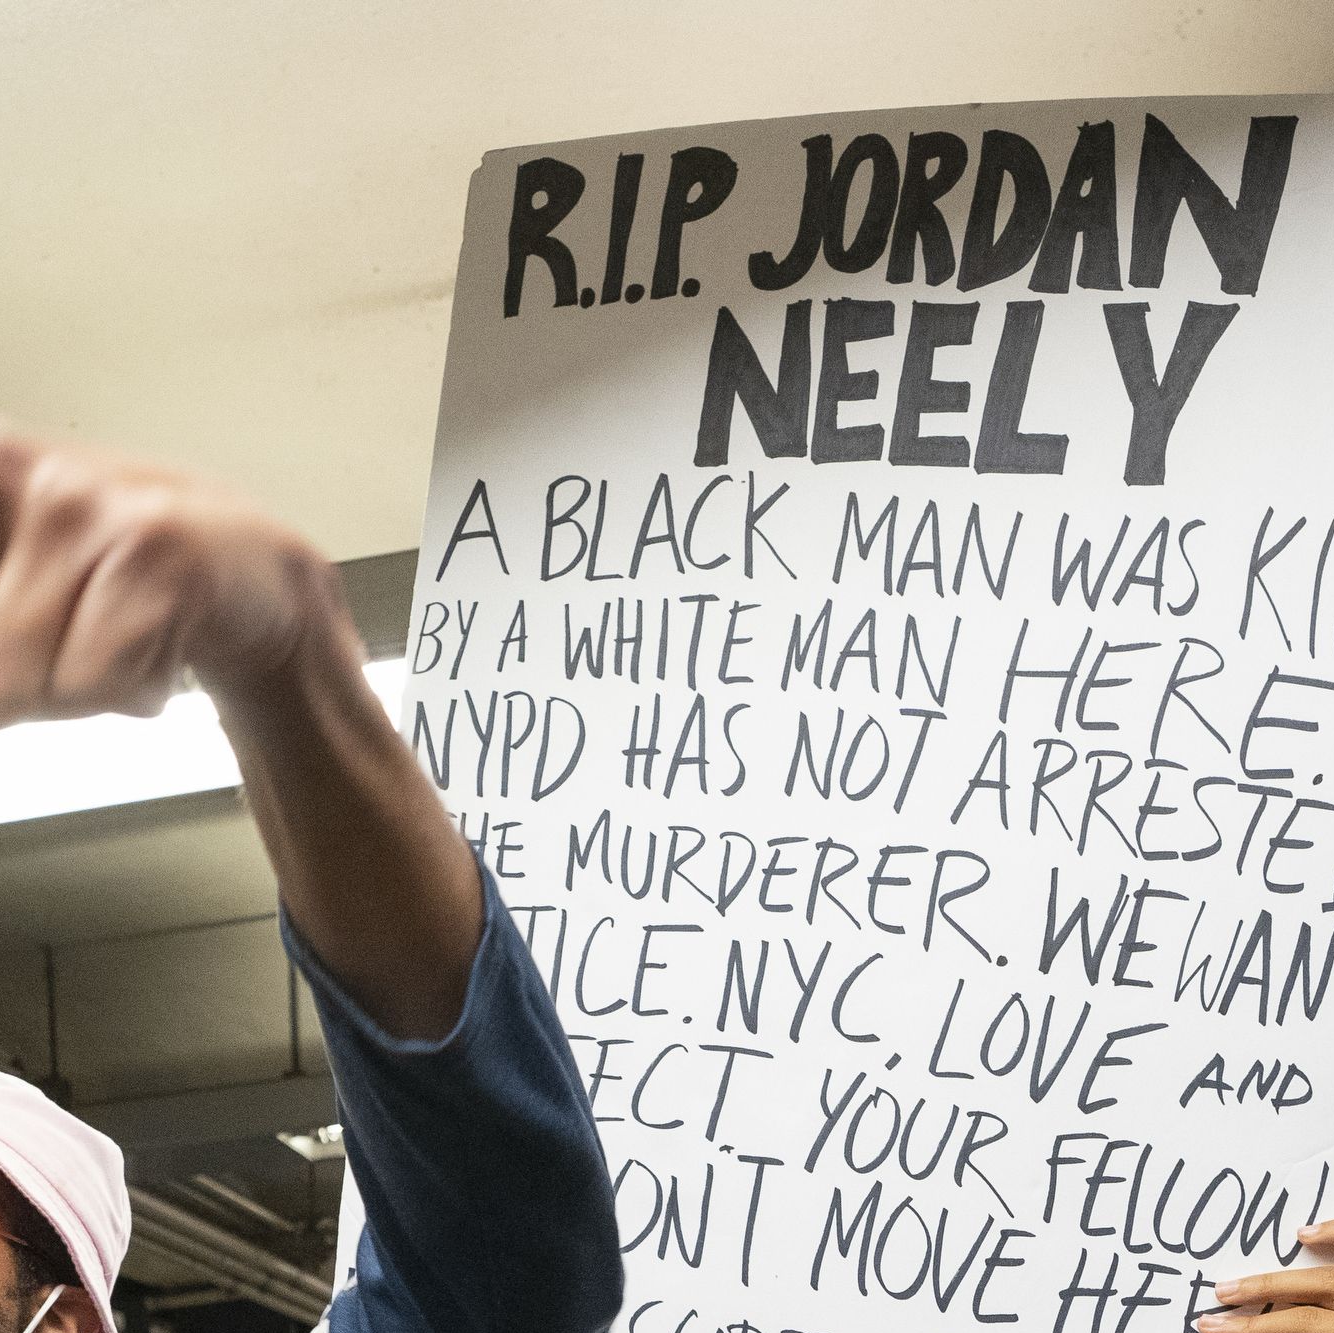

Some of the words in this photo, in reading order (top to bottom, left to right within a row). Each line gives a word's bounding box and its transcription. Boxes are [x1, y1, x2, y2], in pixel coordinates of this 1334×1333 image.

[504, 145, 739, 318] R.I.P.
[748, 113, 1299, 298] JORDAN
[693, 298, 1240, 487] NEELY
[436, 479, 509, 582] A
[540, 470, 797, 582] BLACK
[833, 492, 1022, 600] MAN
[1052, 513, 1207, 617] WAS
[413, 601, 479, 681] BY
[497, 599, 528, 673] A
[564, 594, 762, 692] WHITE
[780, 598, 962, 708] MAN
[413, 689, 586, 802] NYPD
[622, 693, 751, 799] HAS
[784, 707, 948, 814] NOT
[447, 810, 526, 878] HE
[565, 809, 1009, 968] MURDERER.
[929, 979, 1168, 1114] LOVE
[1180, 1053, 1312, 1115] AND
[613, 1143, 785, 1288] ON'T
[810, 1181, 1036, 1324] MOVE
[804, 1068, 1015, 1219] YOUR
[1042, 1132, 1330, 1268] FELLOW
